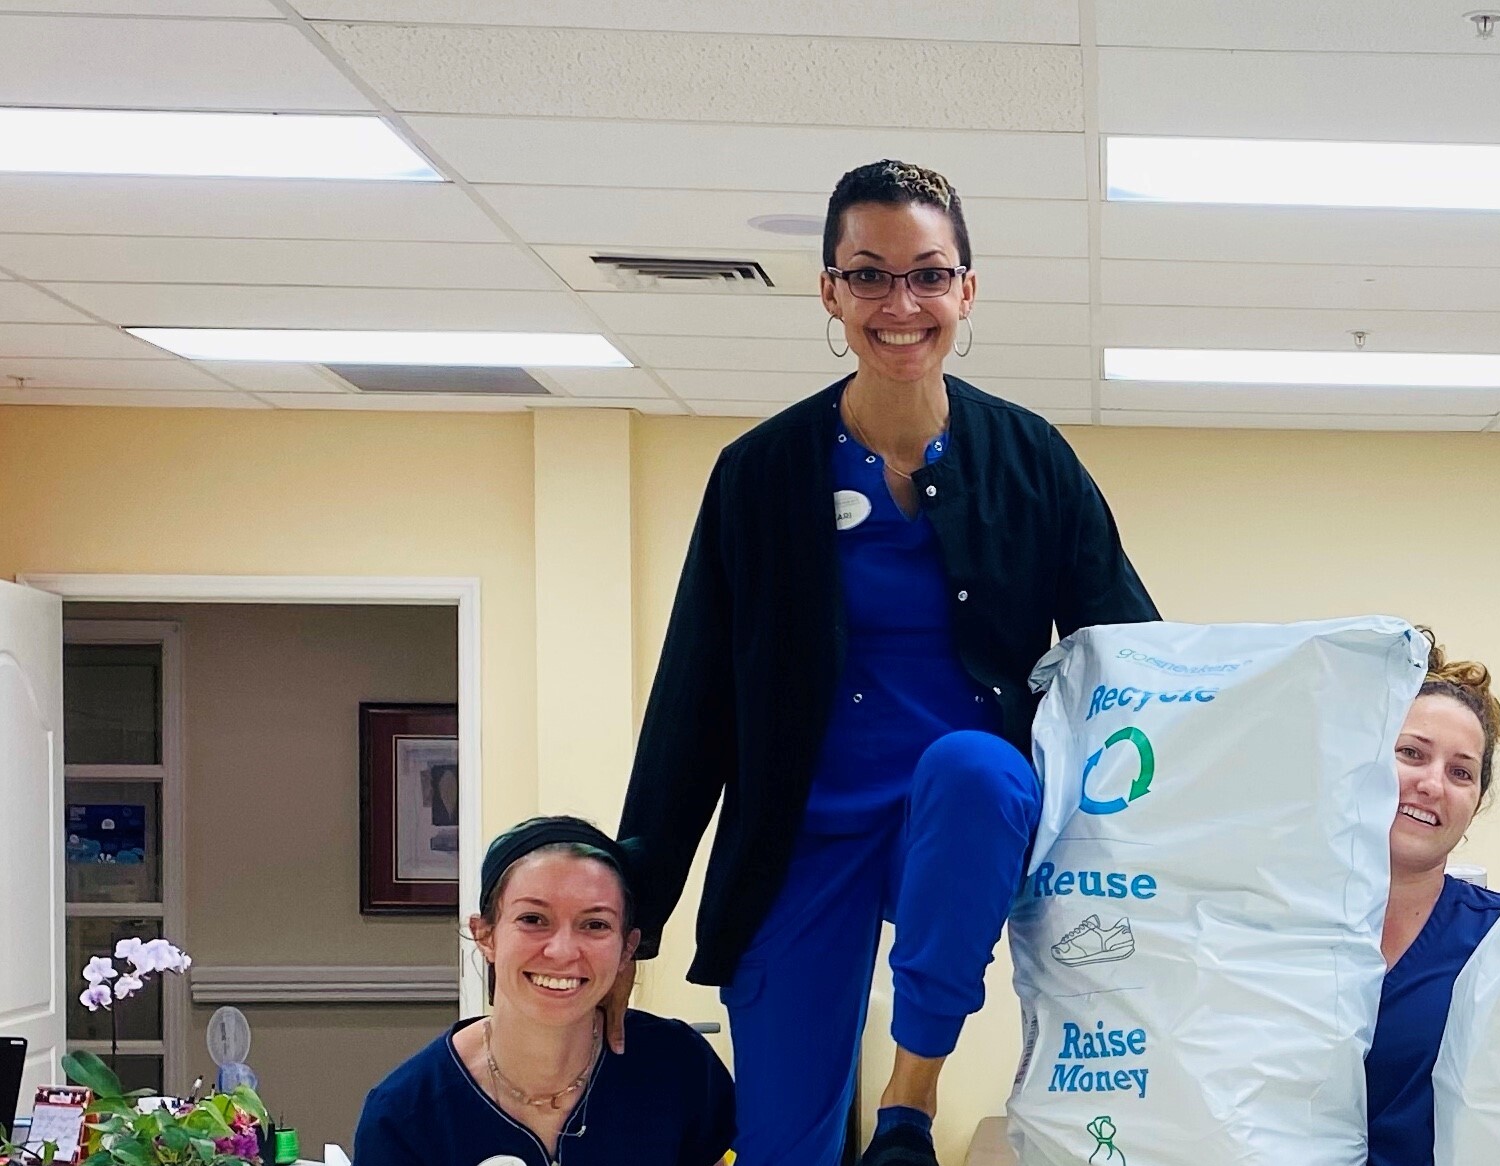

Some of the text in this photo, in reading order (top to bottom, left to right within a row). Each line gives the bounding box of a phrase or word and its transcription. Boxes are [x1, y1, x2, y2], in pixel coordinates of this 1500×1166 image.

[1034, 861, 1157, 899] Reuse
[1058, 1020, 1146, 1059] Raise
[1048, 1064, 1149, 1098] Money
